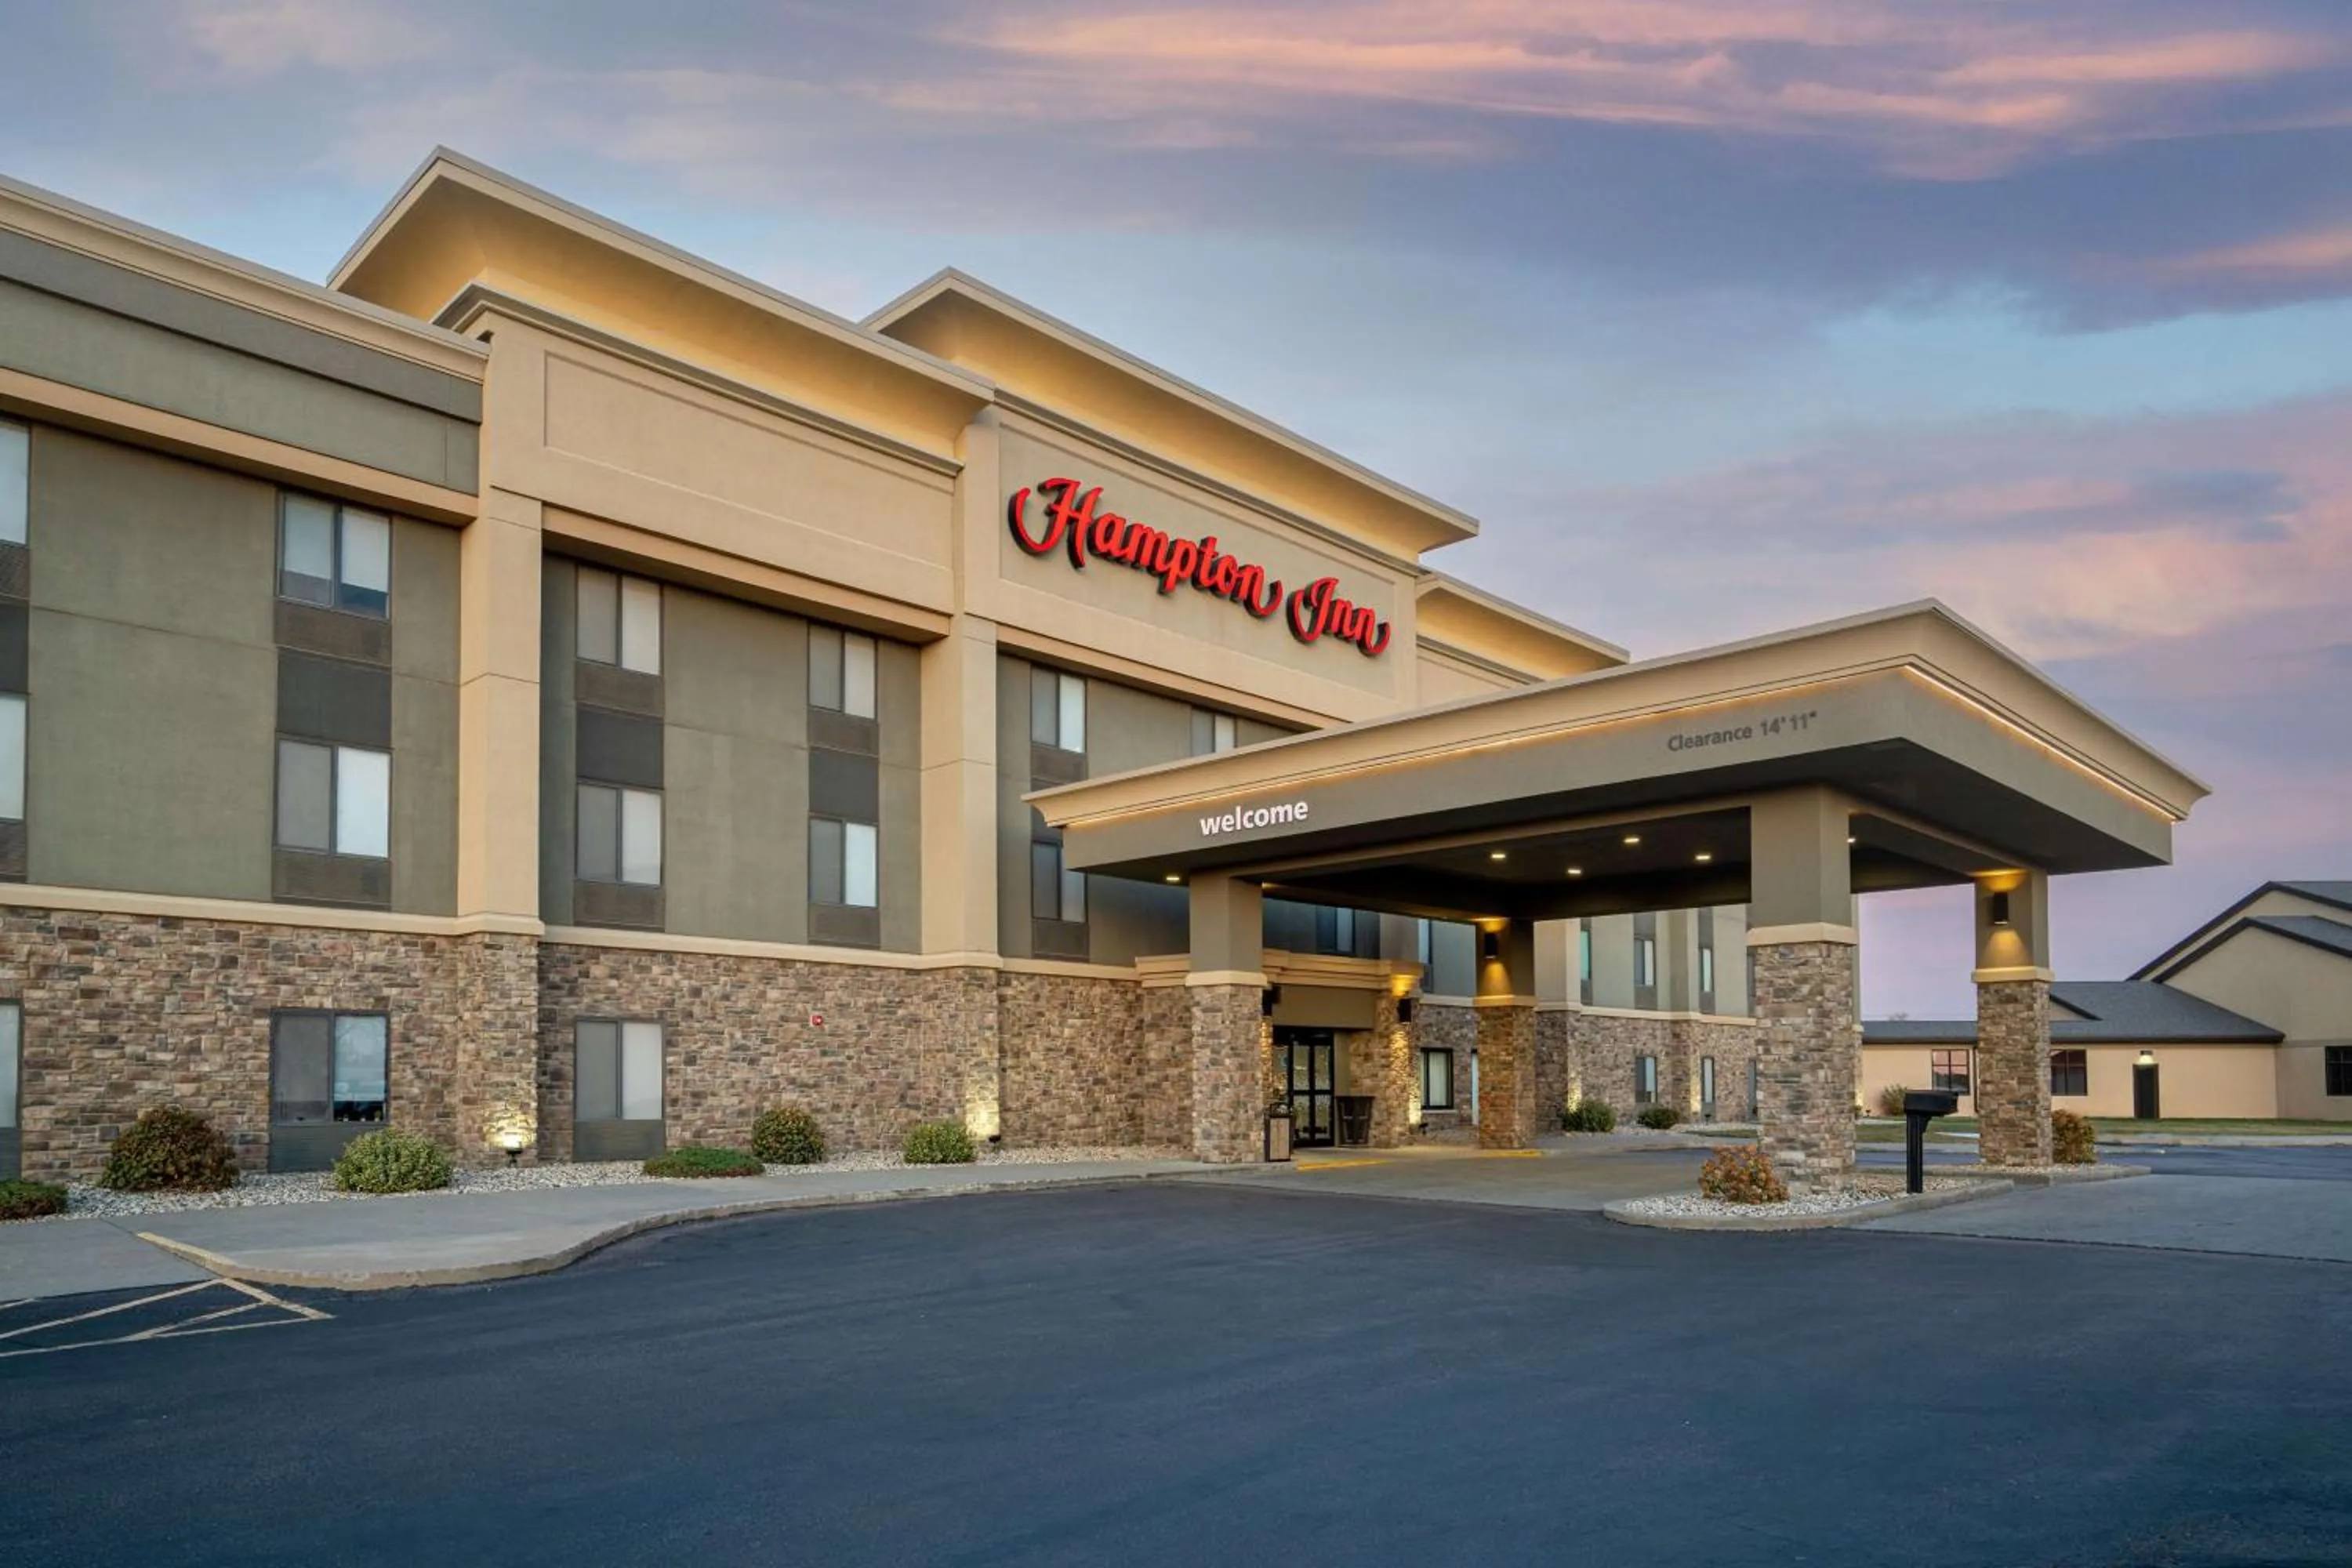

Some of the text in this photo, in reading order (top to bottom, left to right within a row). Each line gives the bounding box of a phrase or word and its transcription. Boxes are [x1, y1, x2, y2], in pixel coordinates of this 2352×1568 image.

[1008, 477, 1390, 656] Hampton Inn
[1668, 727, 1752, 751] Clearance
[1200, 801, 1308, 836] welcome
